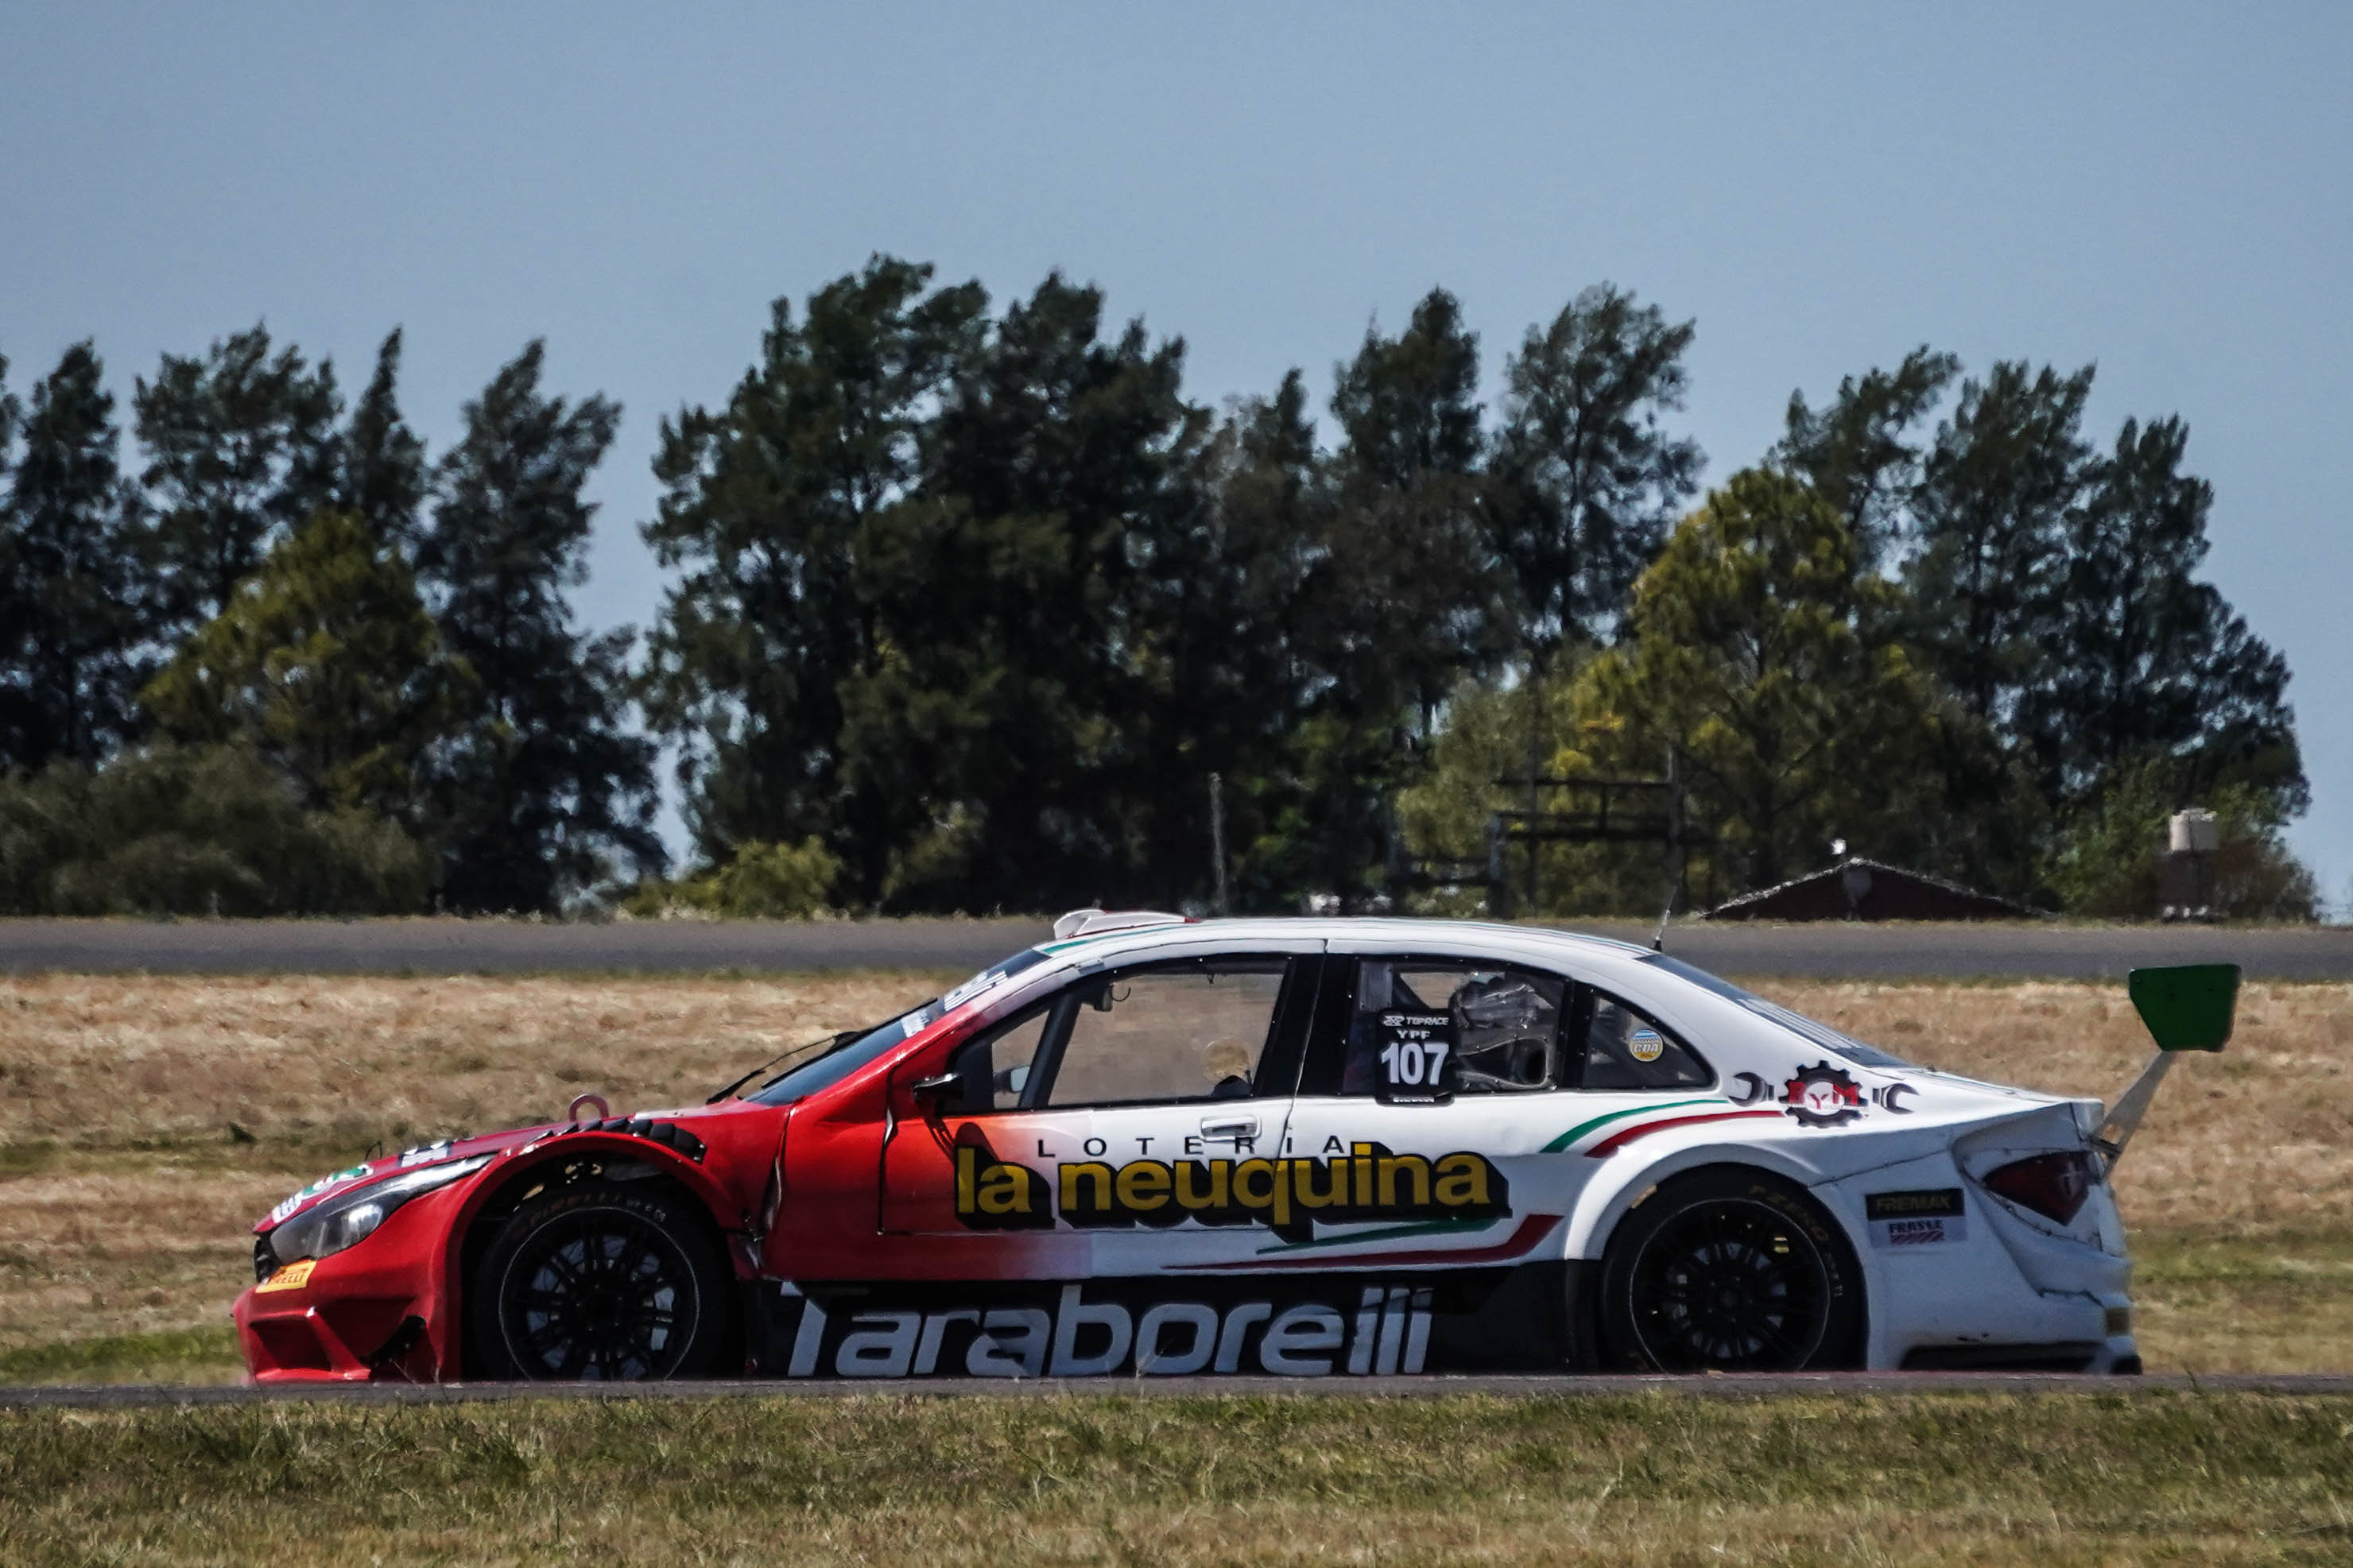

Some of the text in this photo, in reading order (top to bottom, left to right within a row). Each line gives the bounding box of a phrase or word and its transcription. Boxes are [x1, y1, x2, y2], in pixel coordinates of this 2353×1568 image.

[1381, 1042, 1449, 1086] 107
[1037, 1135, 1345, 1158] LOTERIA
[956, 1142, 1493, 1227] la neuquina
